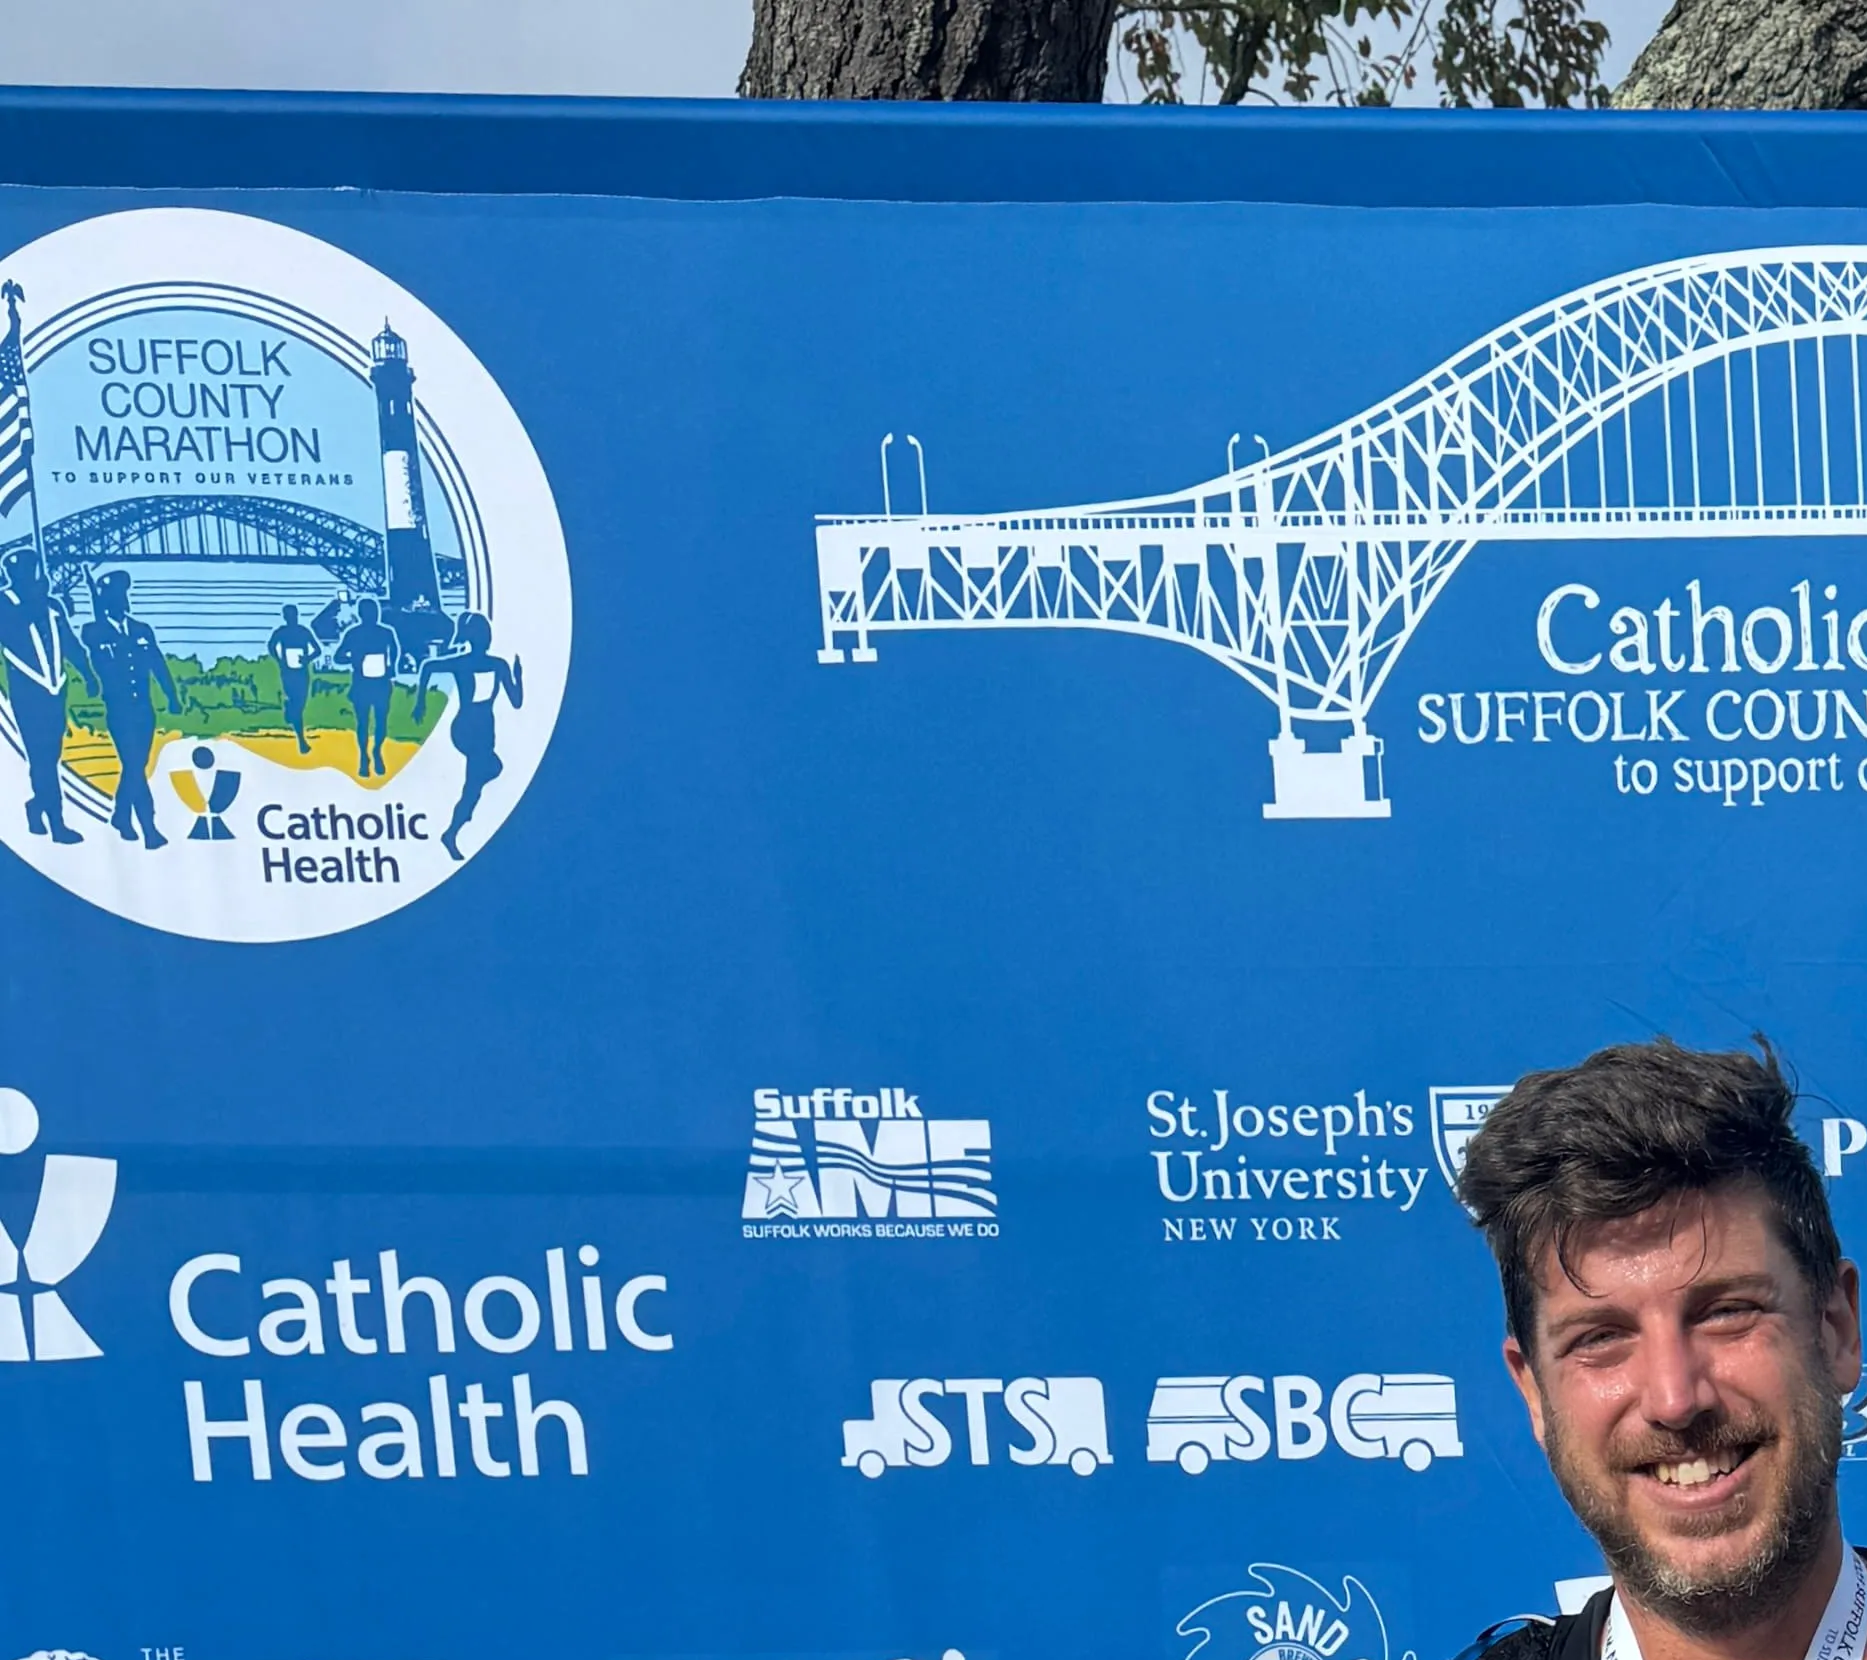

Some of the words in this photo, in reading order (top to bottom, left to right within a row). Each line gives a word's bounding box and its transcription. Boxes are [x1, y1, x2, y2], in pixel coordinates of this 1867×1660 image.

[88, 337, 292, 377] SUFFOLK
[101, 381, 285, 420] COUNTY
[74, 425, 322, 464] MARATHON
[51, 471, 77, 484] TO
[89, 471, 182, 485] SUPPORT
[195, 472, 235, 485] OUR
[247, 472, 354, 486] VETERANS
[1418, 690, 1690, 745] SUFFOLK
[1614, 754, 1658, 795] to
[1673, 753, 1844, 807] support
[257, 802, 429, 841] Catholic
[262, 846, 401, 884] Health
[753, 1087, 923, 1119] Suffolk
[1146, 1090, 1208, 1138] St.
[1210, 1089, 1414, 1156] Joseph's
[1150, 1151, 1429, 1212] University
[742, 1224, 811, 1239] SUFFOLK
[813, 1223, 873, 1238] WORKS
[875, 1223, 945, 1238] BECAUSE
[947, 1223, 974, 1237] WE
[977, 1222, 1000, 1237] DO
[1162, 1217, 1237, 1242] NEW
[1250, 1217, 1341, 1241] YORK
[169, 1244, 674, 1357] Catholic
[183, 1373, 589, 1482] Health
[1246, 1600, 1349, 1657] SAND
